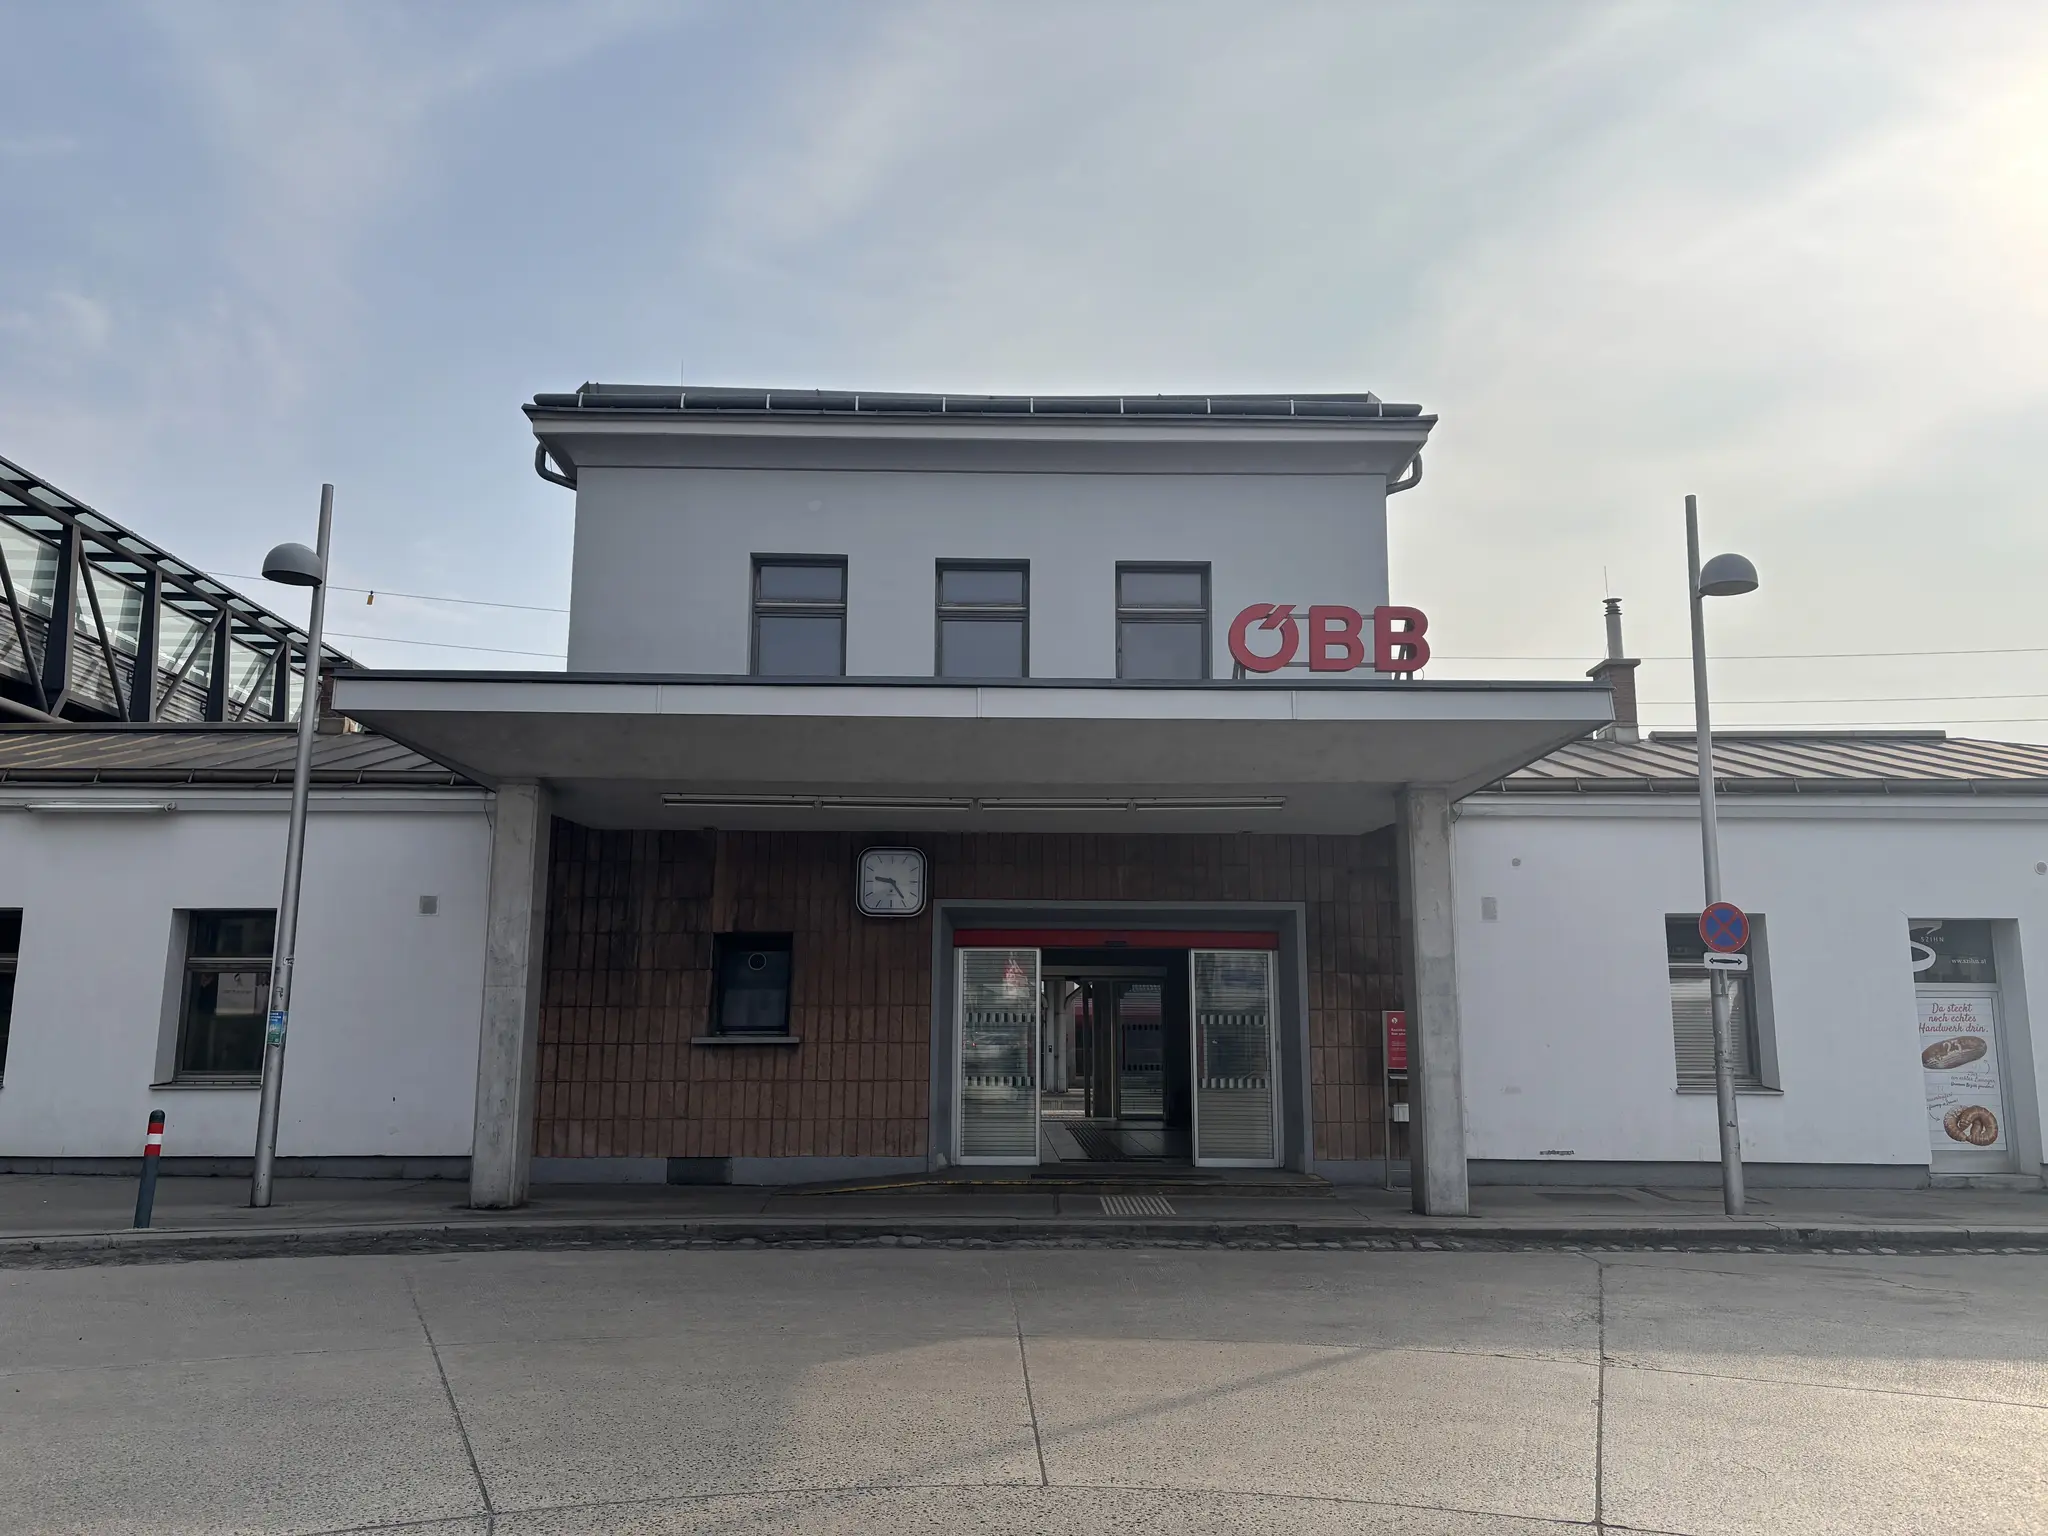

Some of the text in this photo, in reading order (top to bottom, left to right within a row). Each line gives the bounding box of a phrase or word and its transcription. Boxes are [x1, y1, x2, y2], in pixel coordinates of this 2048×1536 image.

[1228, 603, 1430, 673] ÖBB
[1932, 1002, 1973, 1014] Da steckt
[1928, 1013, 1977, 1022] noch echtes
[1919, 1022, 1989, 1034] Handwerk drin.
